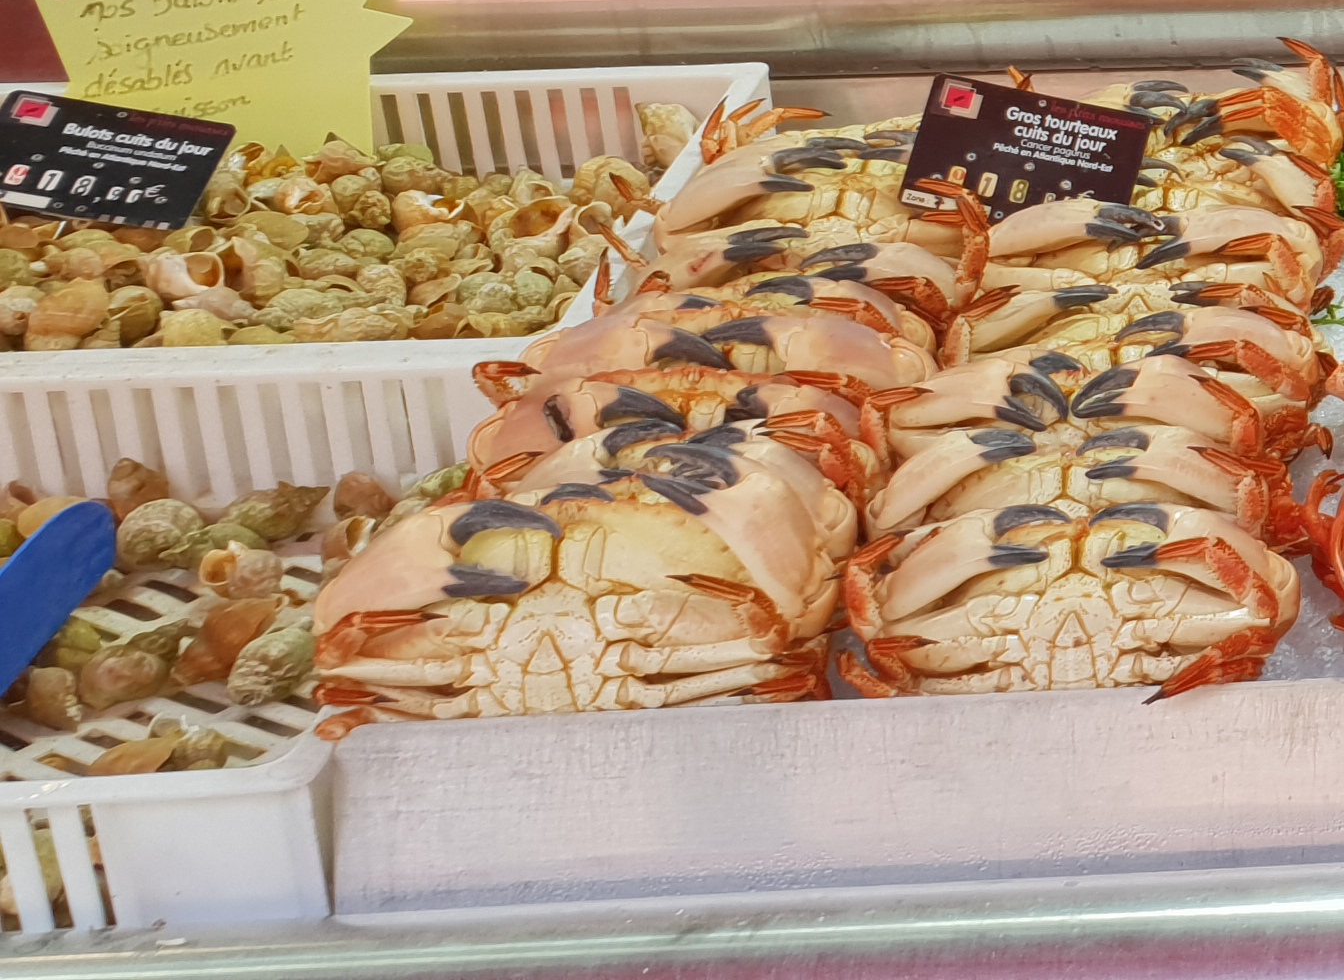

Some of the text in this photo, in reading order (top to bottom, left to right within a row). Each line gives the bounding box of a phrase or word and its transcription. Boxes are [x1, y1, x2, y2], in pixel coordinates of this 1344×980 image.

[1006, 106, 1118, 141] Gros tourteaux
[62, 122, 115, 142] Bulots
[115, 132, 152, 148] cuits
[155, 138, 179, 151] du
[179, 139, 214, 157] jour
[1014, 125, 1108, 152] cuits du jour
[1020, 139, 1053, 152] Cancer
[1020, 148, 1032, 157] en
